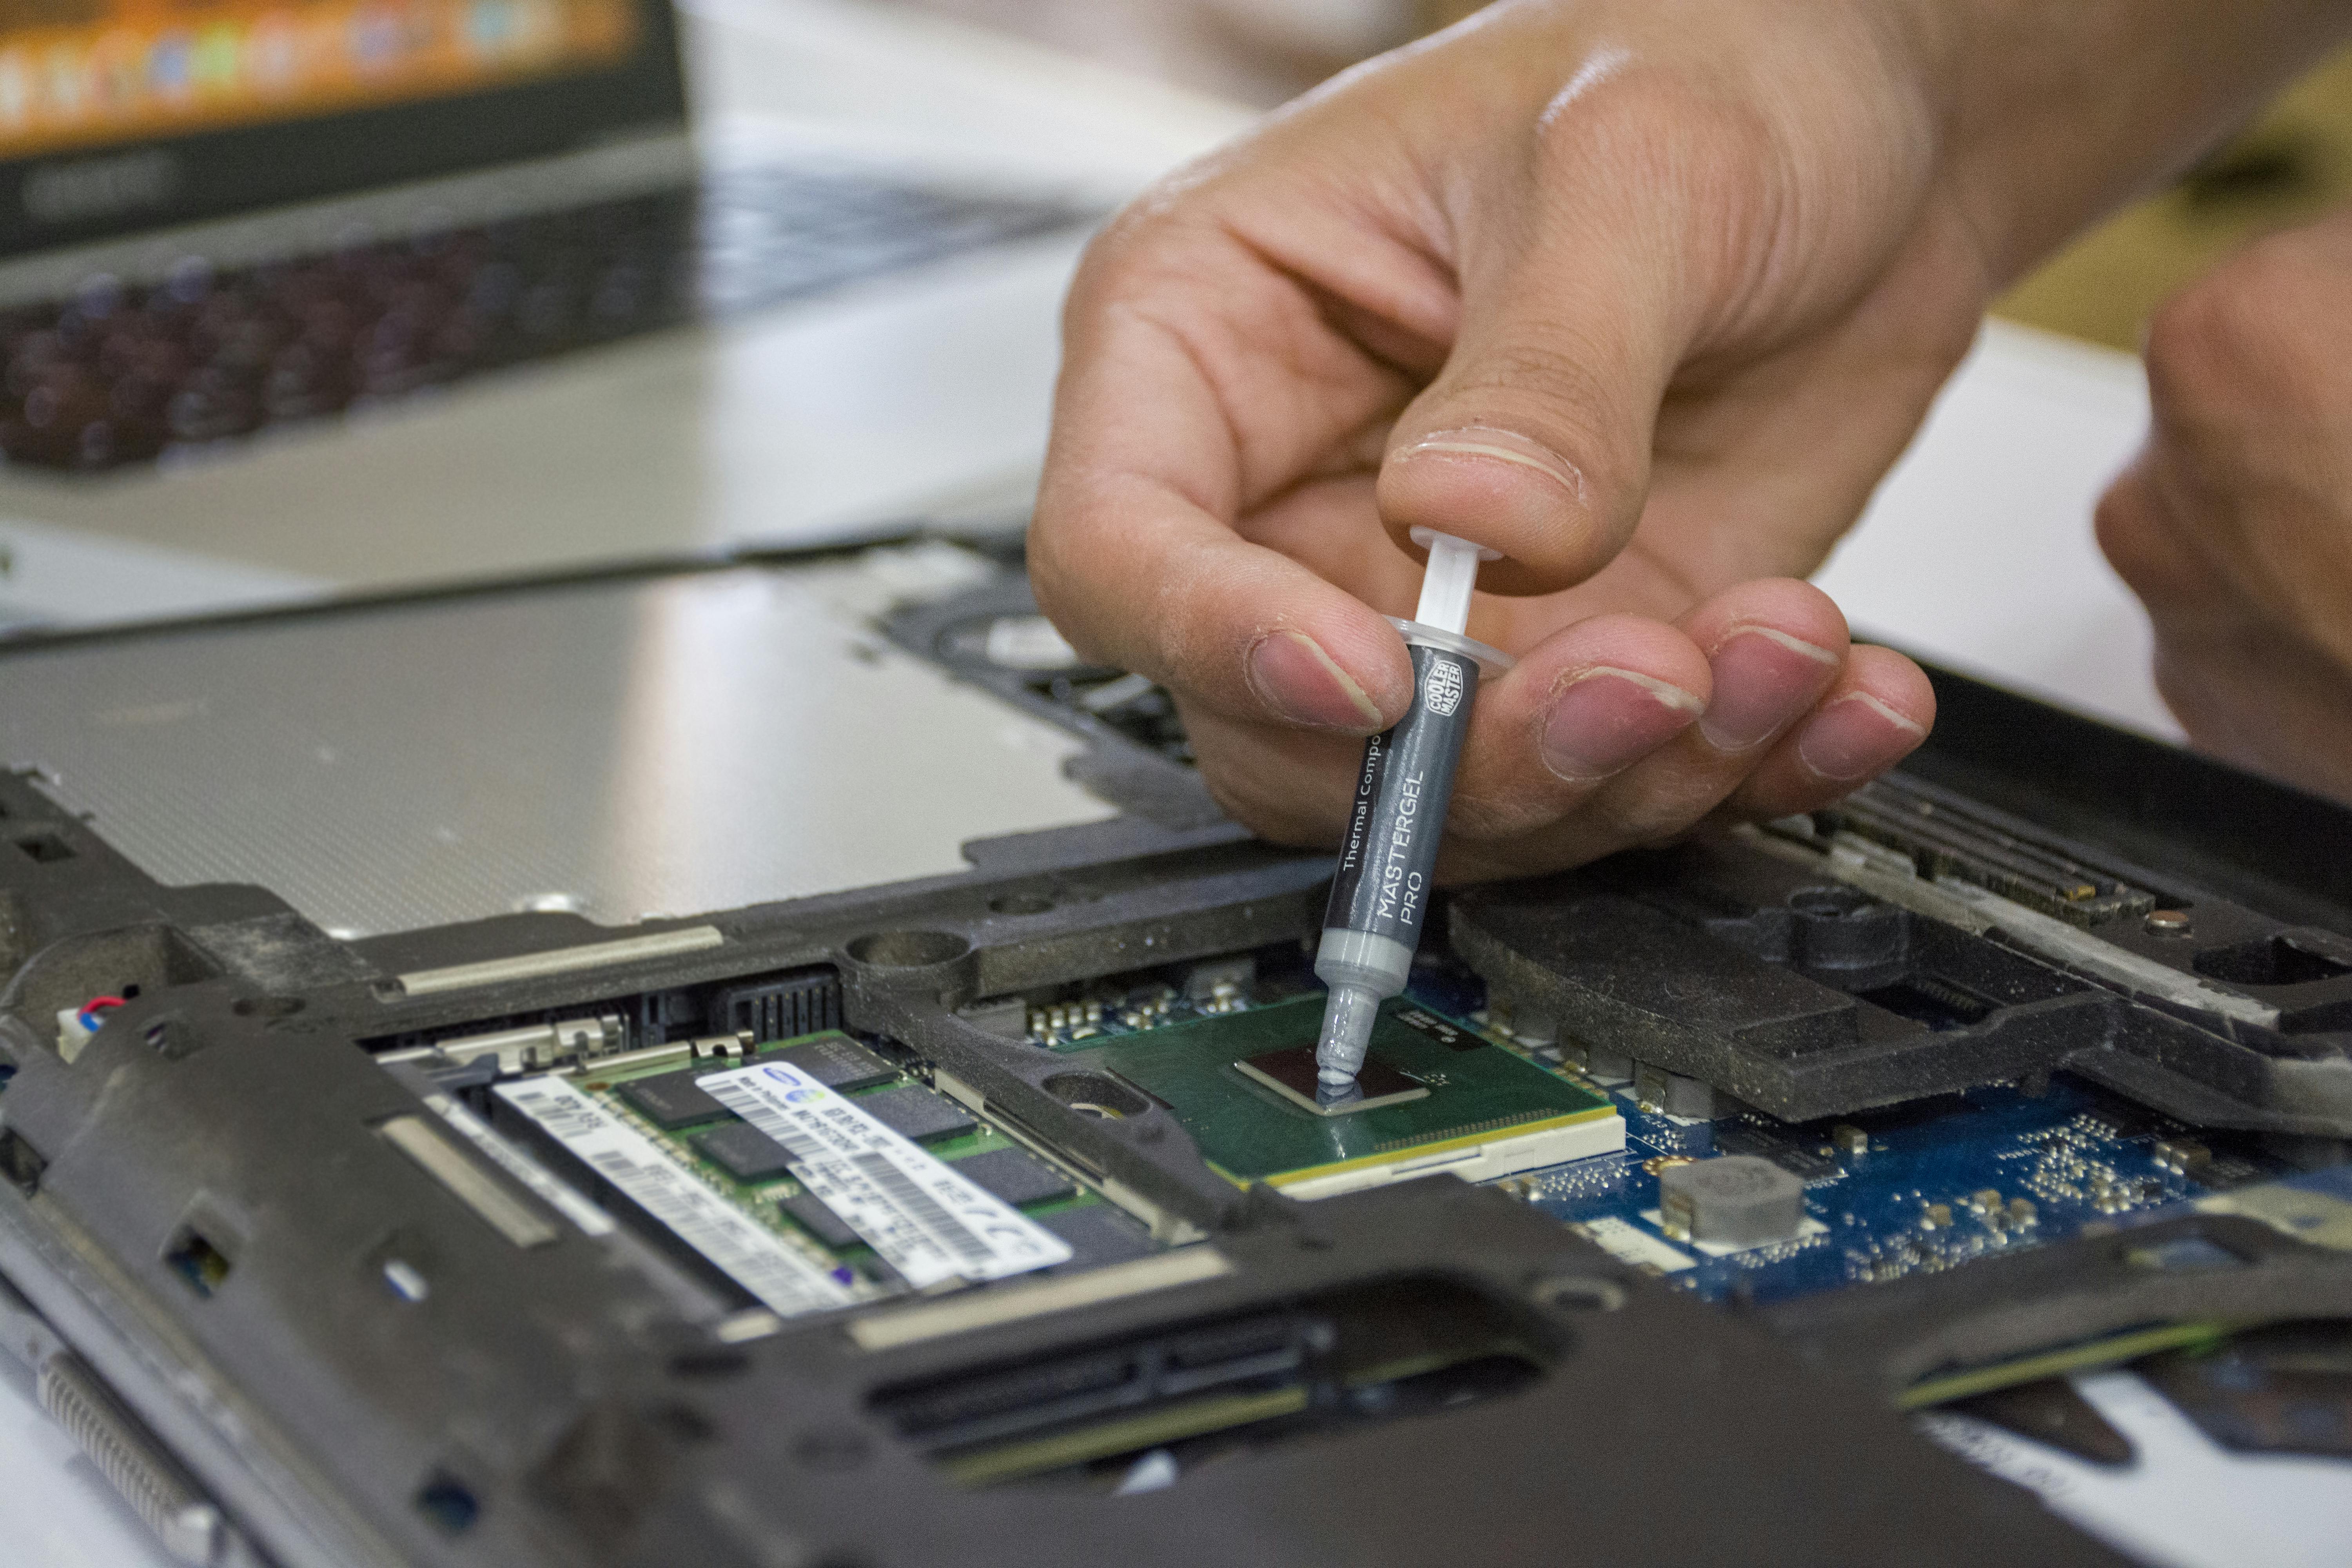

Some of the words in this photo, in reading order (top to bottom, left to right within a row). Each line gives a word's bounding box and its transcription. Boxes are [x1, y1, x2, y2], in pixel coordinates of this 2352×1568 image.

[1427, 663, 1450, 710] COOLER
[1440, 666, 1461, 713] MASTER
[1343, 801, 1368, 871] Thermal
[1377, 770, 1424, 918] MASTERGEL
[1400, 871, 1422, 925] PRO
